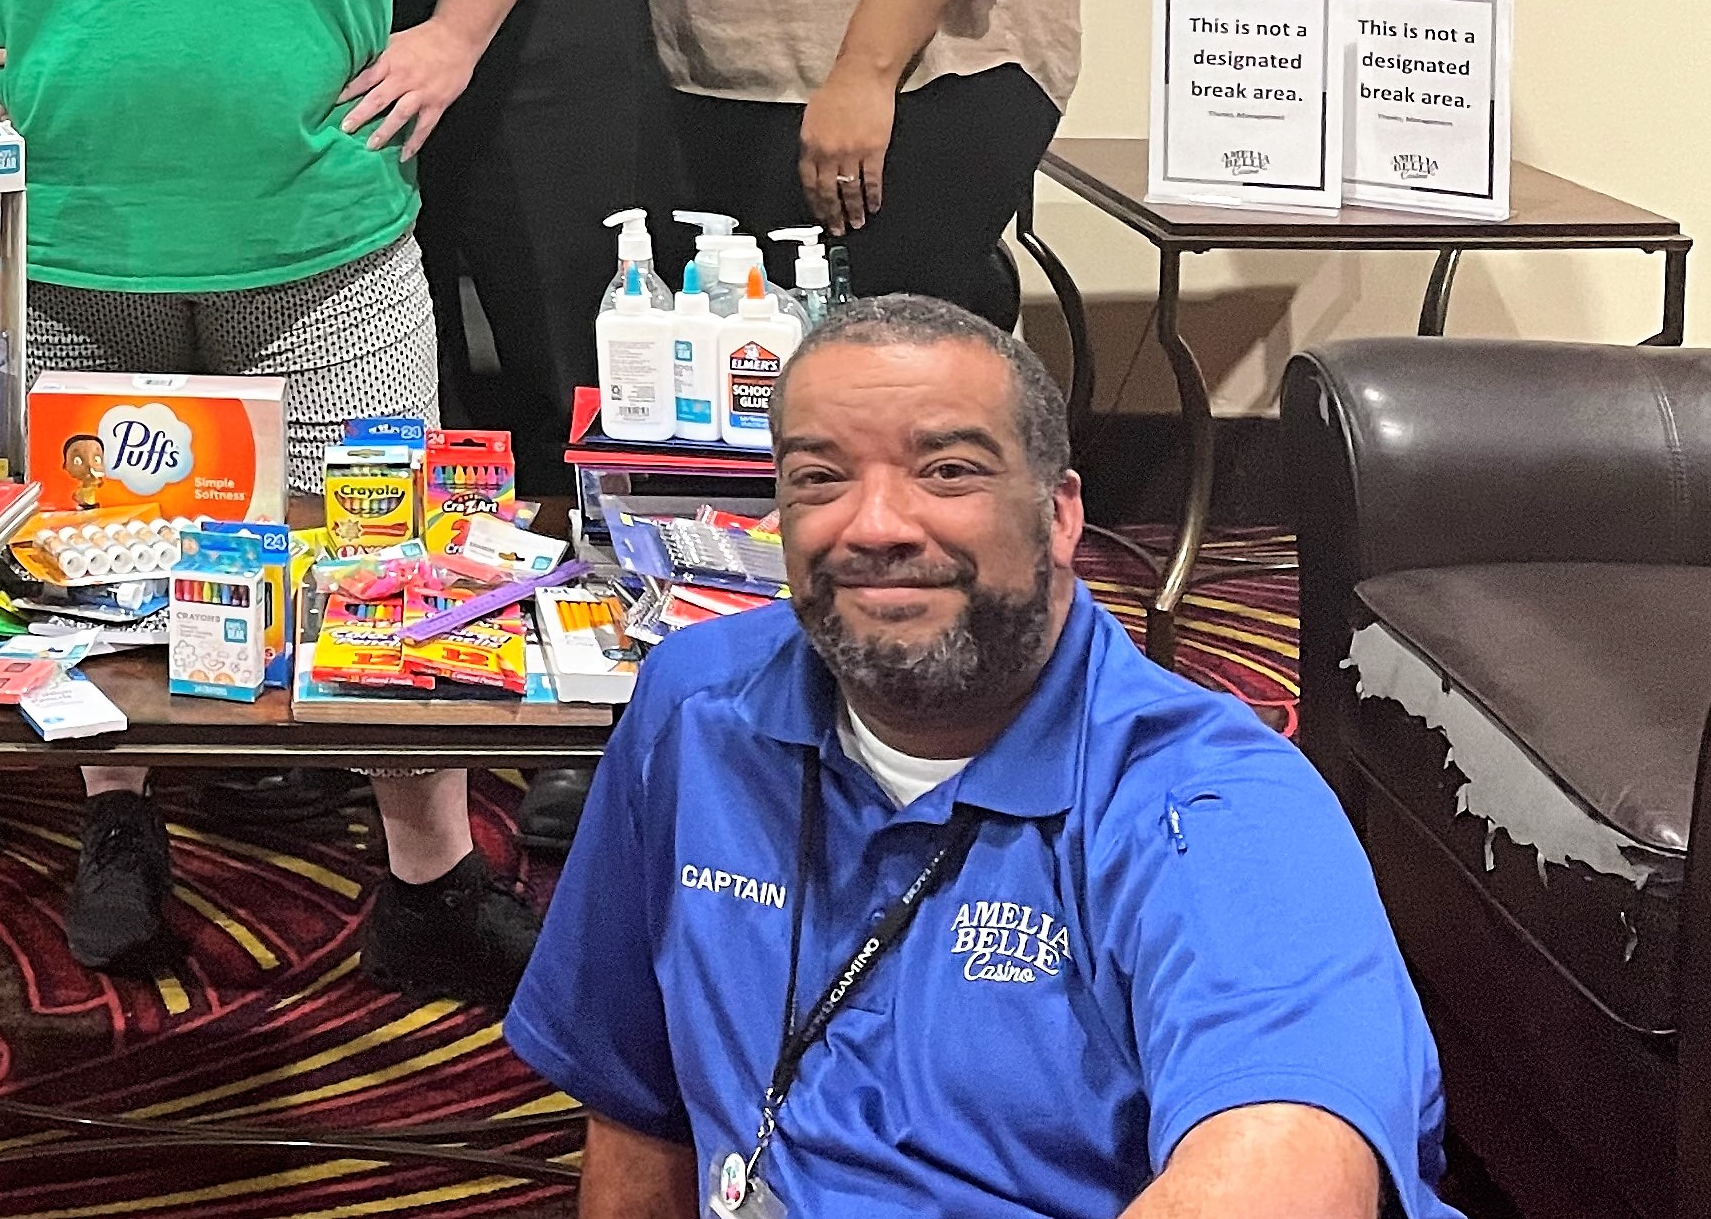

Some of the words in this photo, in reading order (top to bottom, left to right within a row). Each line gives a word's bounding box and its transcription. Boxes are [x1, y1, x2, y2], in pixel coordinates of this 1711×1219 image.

[1189, 18, 1229, 34] This
[1235, 18, 1250, 35] is
[1257, 21, 1291, 37] not
[1296, 24, 1307, 38] a
[1358, 19, 1397, 37] This
[1403, 22, 1418, 39] is
[1424, 26, 1458, 43] not
[1464, 30, 1475, 44] a
[1193, 49, 1302, 71] designated
[1362, 52, 1470, 76] designated
[1191, 81, 1247, 99] break
[1253, 85, 1304, 102] area.
[1360, 83, 1415, 103] break
[1421, 90, 1471, 109] area.
[731, 358, 778, 371] ELMER'S
[732, 384, 774, 397] SCHOO
[739, 396, 770, 409] GLUE
[111, 420, 180, 475] Puffs
[427, 433, 446, 445] 24
[194, 476, 235, 490] Simple
[341, 484, 399, 499] Crayola
[194, 489, 245, 502] Softness
[263, 533, 287, 551] 24
[450, 518, 471, 547] 2
[681, 864, 787, 909] CAPTAIN
[950, 900, 1073, 961] AMELIA
[950, 927, 1060, 976] BELLE
[963, 951, 1037, 982] Casino
